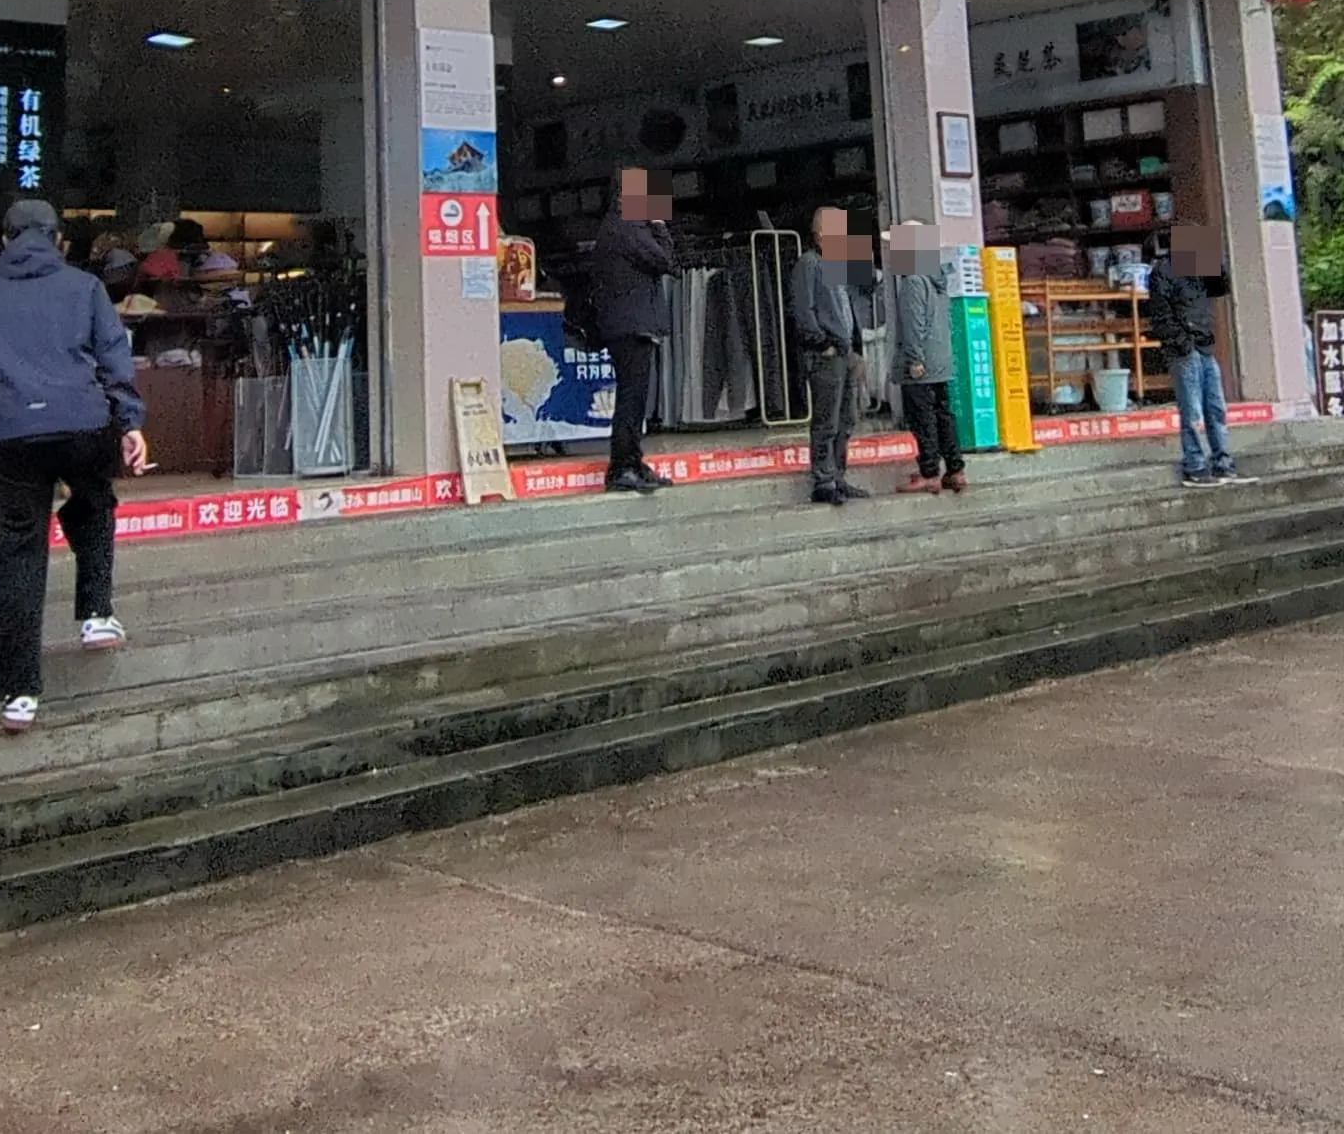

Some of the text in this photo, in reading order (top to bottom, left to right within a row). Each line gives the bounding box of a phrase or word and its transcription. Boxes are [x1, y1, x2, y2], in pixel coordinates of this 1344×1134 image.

[19, 88, 42, 188] 有机绿茶
[428, 229, 474, 244] 吸烟区
[576, 363, 616, 380] 只为更
[1321, 318, 1344, 417] 加水服务
[647, 460, 688, 479] 光临
[198, 495, 290, 525] 欢迎光临
